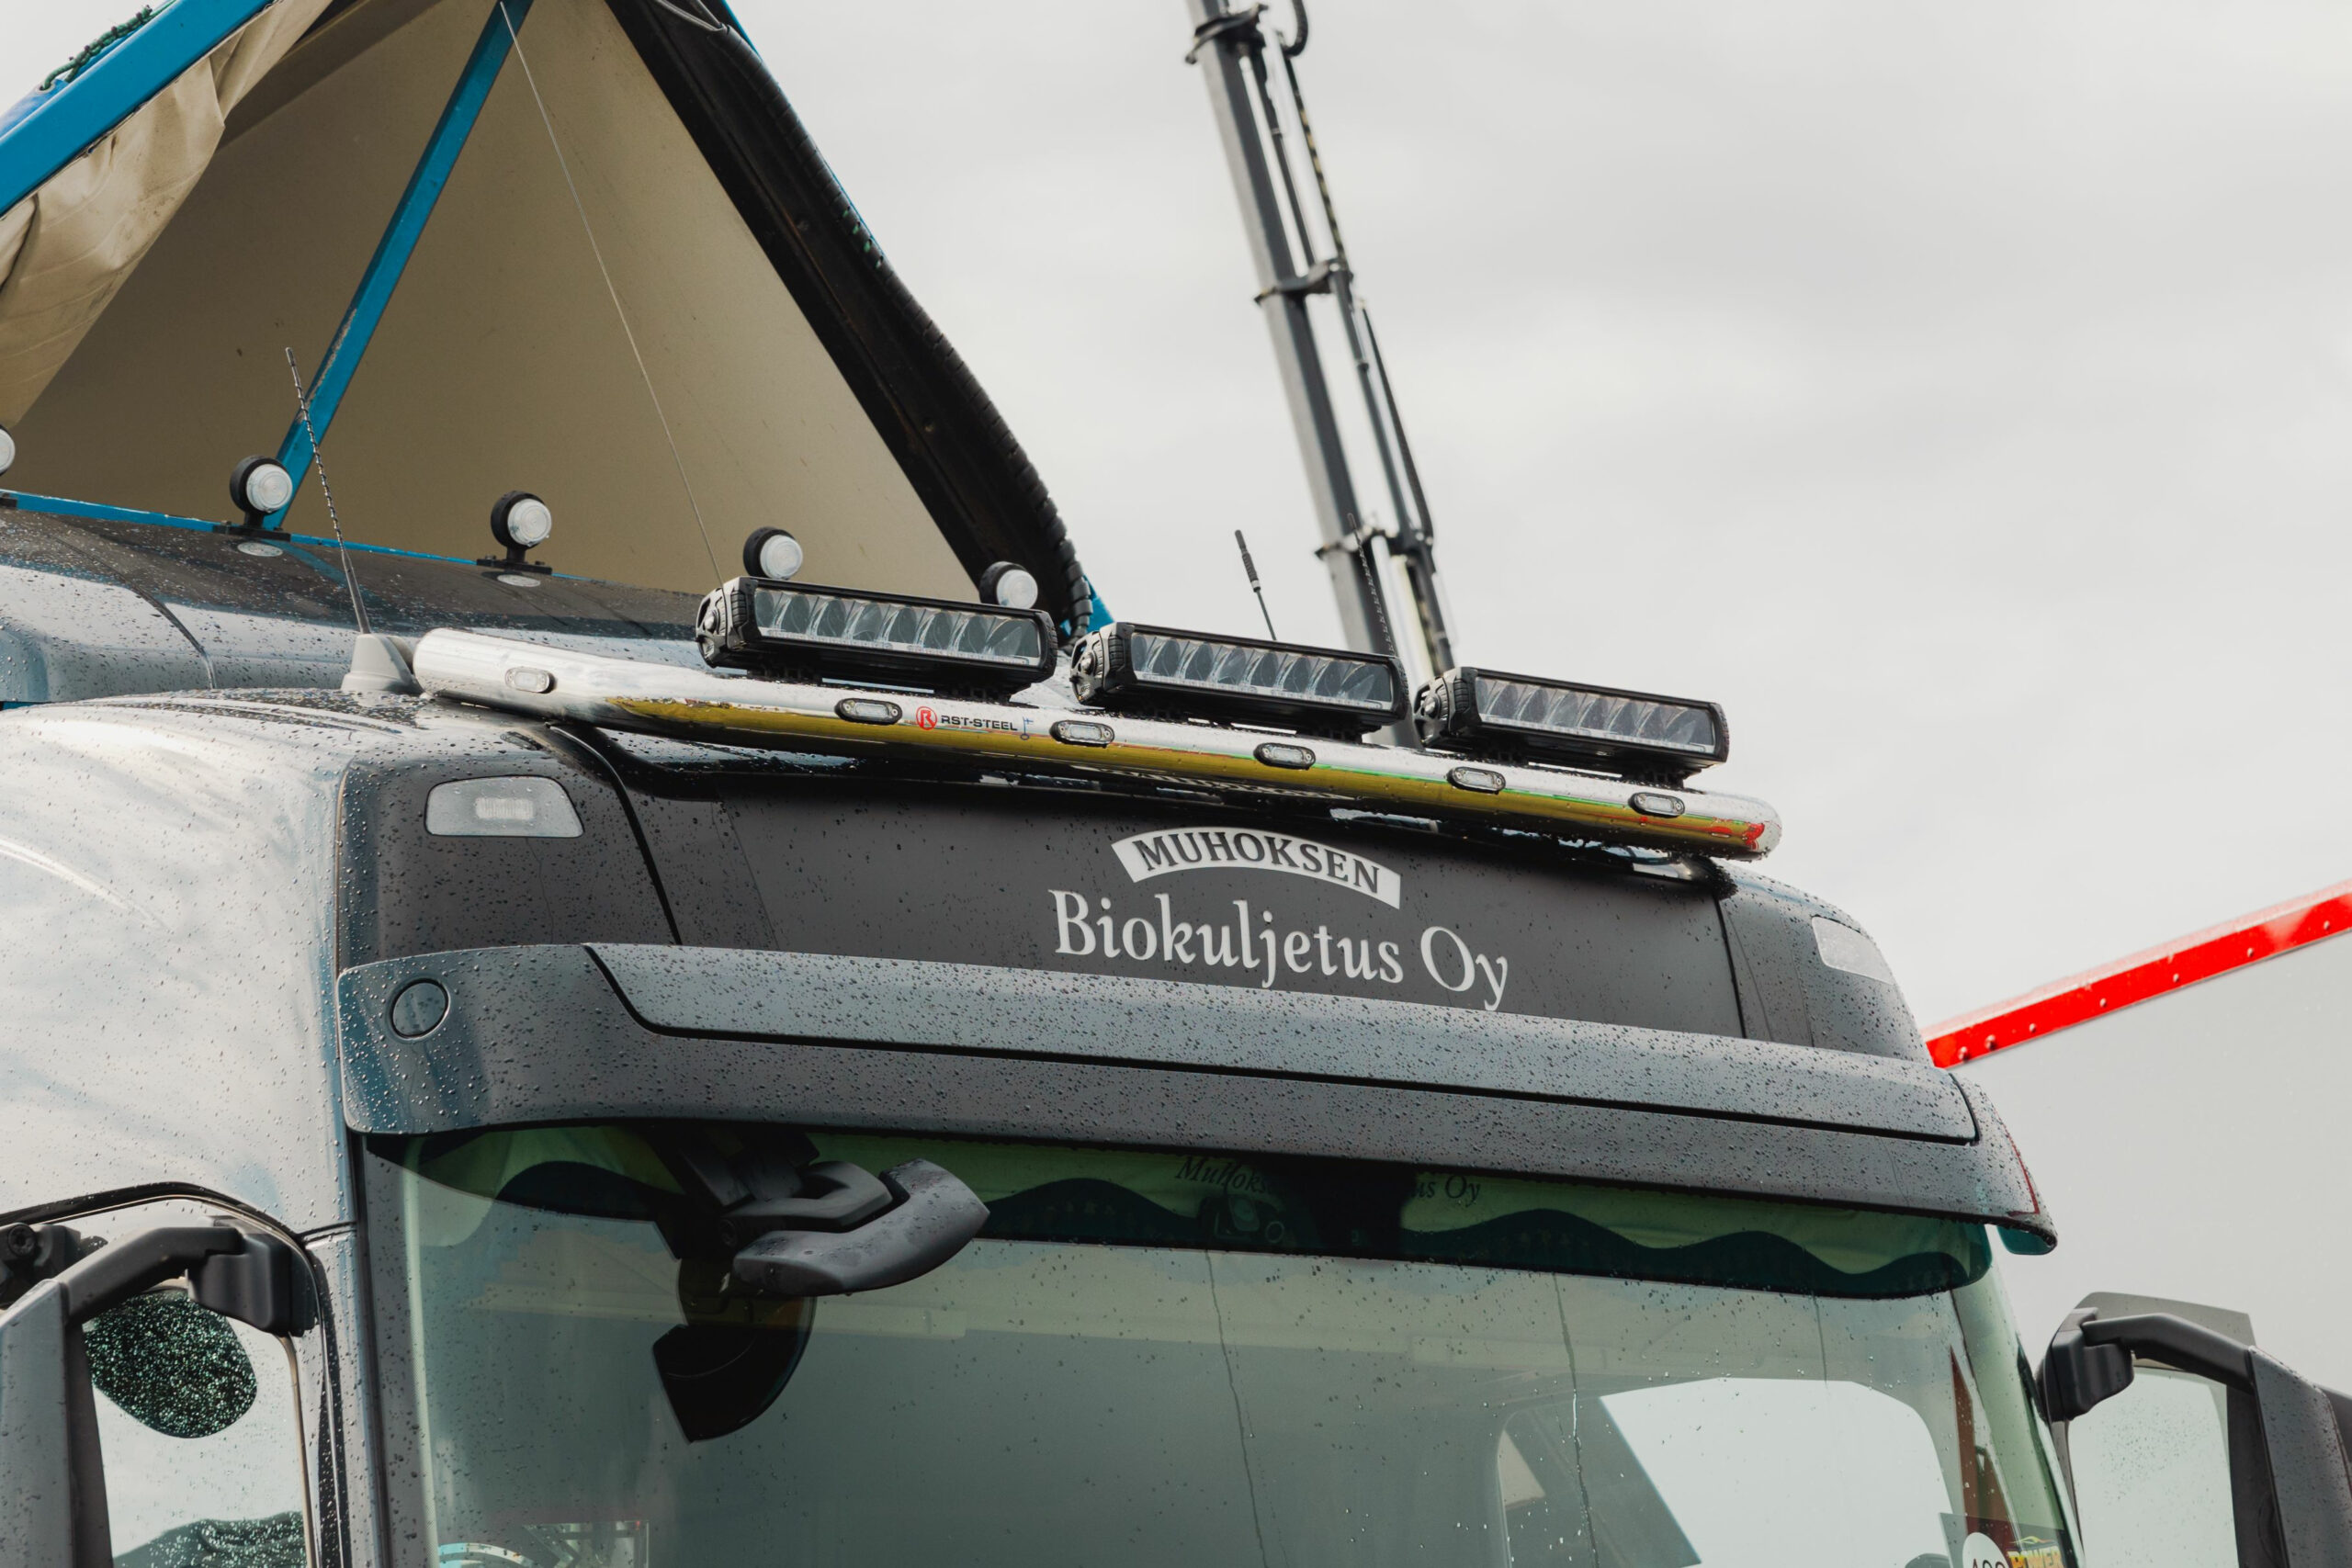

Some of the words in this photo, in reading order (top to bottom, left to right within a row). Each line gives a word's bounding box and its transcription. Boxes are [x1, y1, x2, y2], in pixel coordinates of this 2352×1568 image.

[941, 715, 1019, 732] RST-STEEL
[1132, 830, 1381, 895] MUHOKSEN
[1047, 888, 1404, 988] Biokuljetus
[1419, 926, 1509, 1011] Oy
[1174, 1155, 1267, 1193] Muhoks
[1444, 1174, 1482, 1208] Oy
